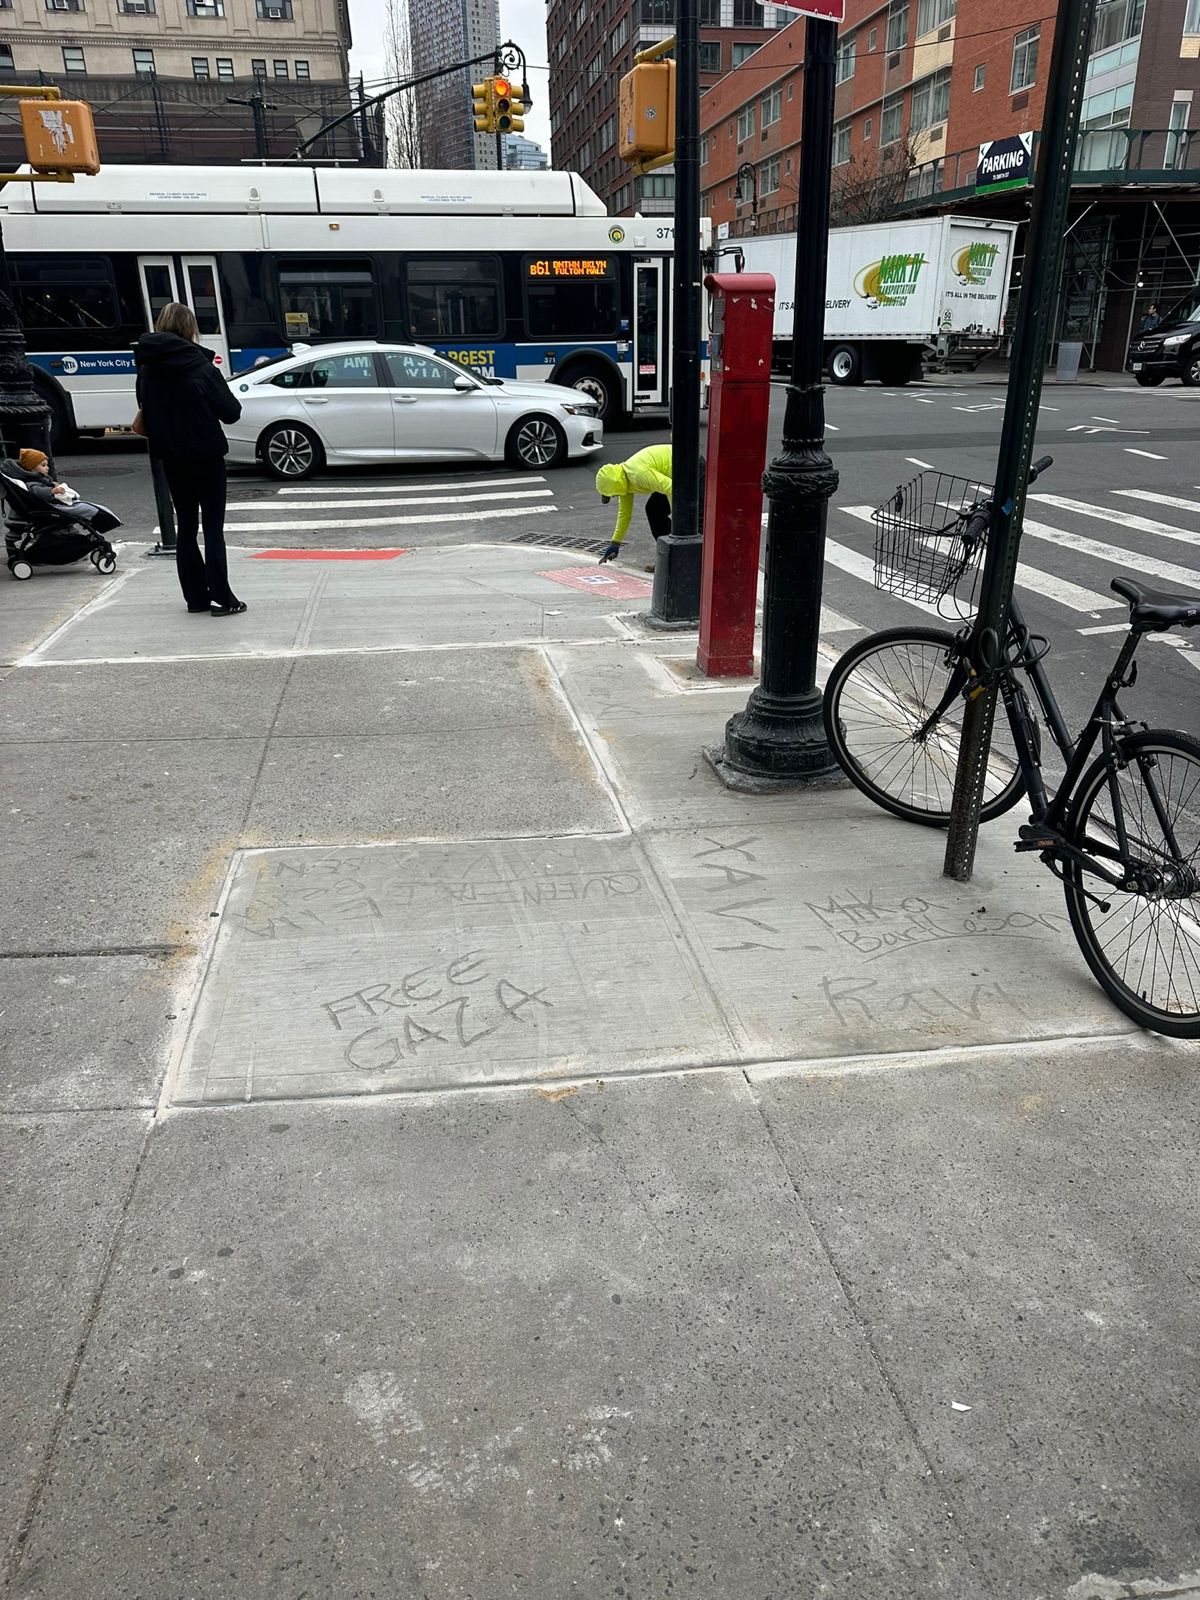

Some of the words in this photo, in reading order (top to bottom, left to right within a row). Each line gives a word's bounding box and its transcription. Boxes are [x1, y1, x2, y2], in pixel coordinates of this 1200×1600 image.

[982, 150, 1024, 174] PARKING
[969, 242, 990, 267] MARK
[530, 260, 550, 275] B61
[555, 267, 584, 275] FULTON
[586, 267, 606, 275] MALL
[582, 260, 607, 269] BKLYN
[878, 253, 911, 284] MARK
[908, 253, 925, 283] IV
[779, 302, 790, 310] IT'S
[825, 299, 851, 309] ELIVERY
[969, 292, 977, 300] THE
[80, 360, 97, 368] New
[115, 359, 130, 368] City
[522, 873, 643, 907] QUEEN
[321, 949, 490, 1031] FREE
[345, 978, 554, 1074] GAZA
